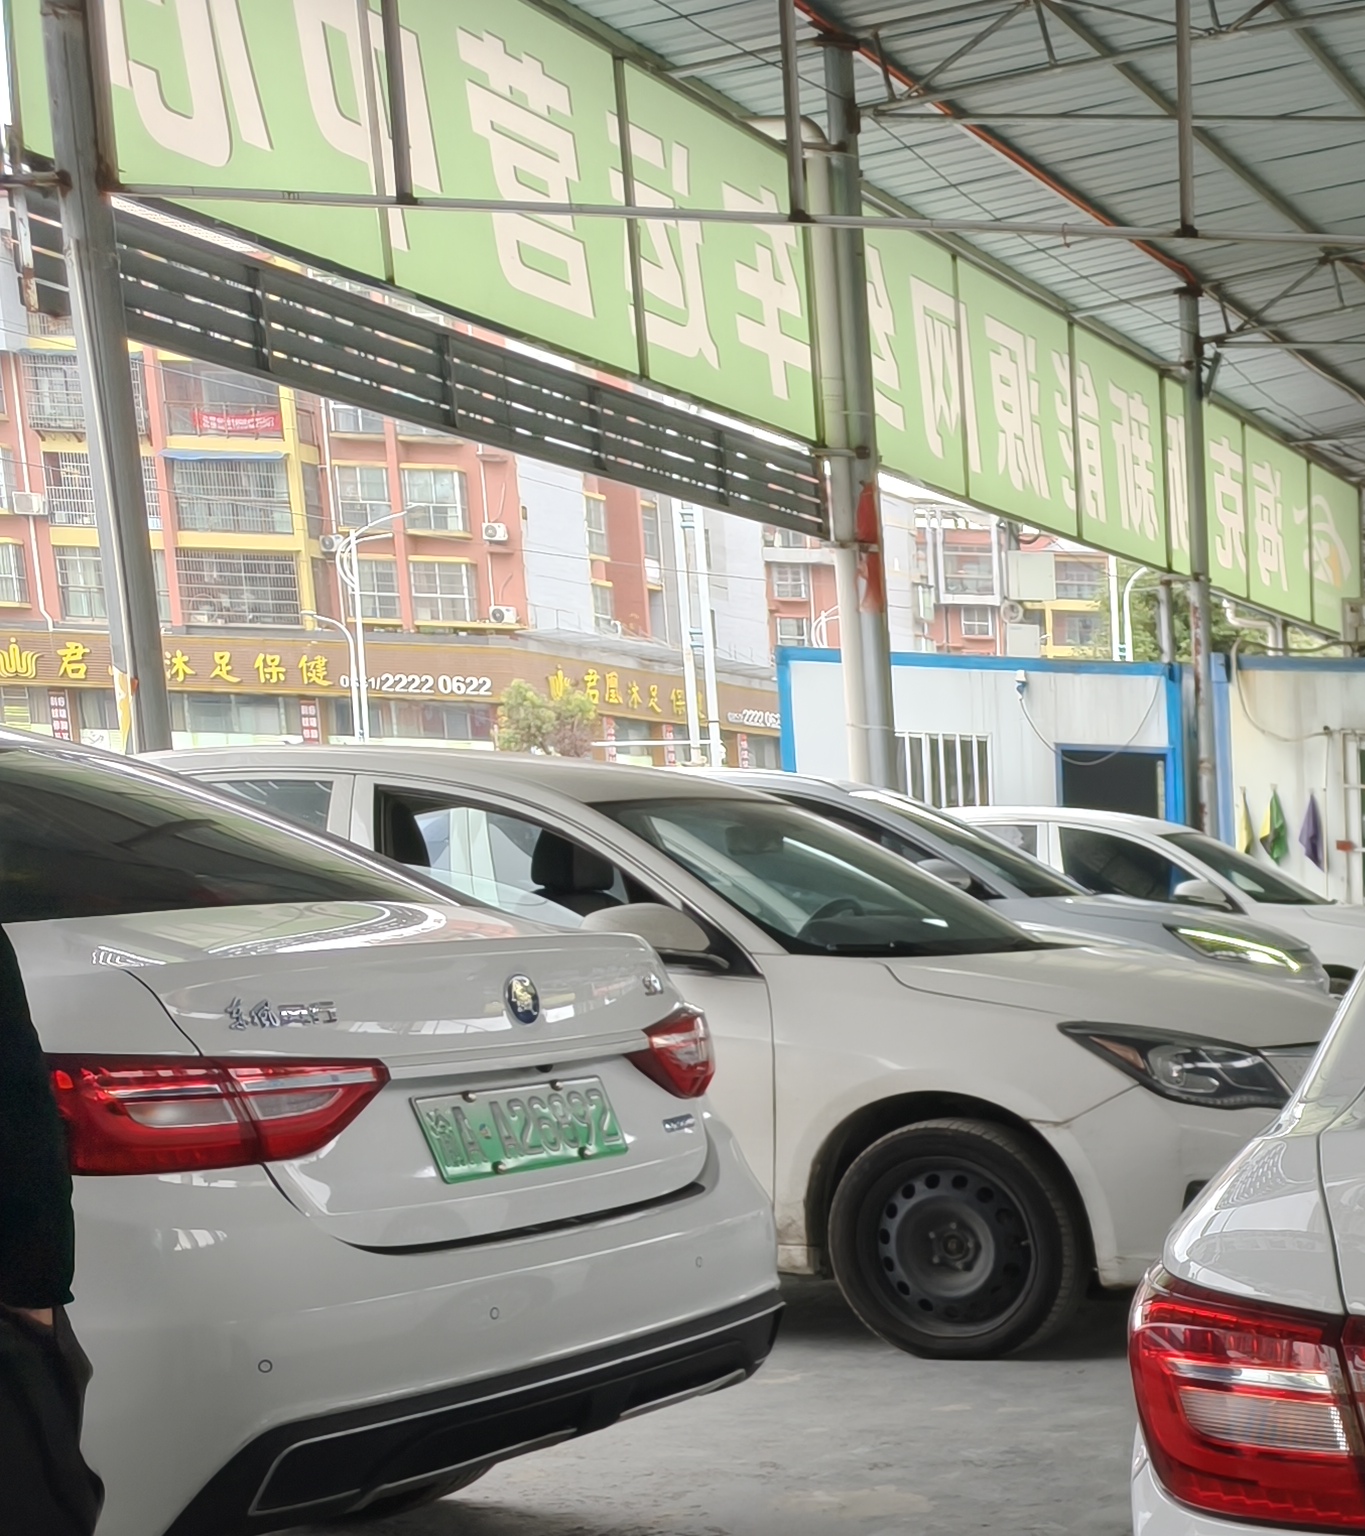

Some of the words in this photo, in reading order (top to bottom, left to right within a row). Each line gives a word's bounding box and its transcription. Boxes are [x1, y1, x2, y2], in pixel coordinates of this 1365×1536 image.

[57, 641, 334, 687] 君沐足保健
[437, 675, 493, 696] 0622
